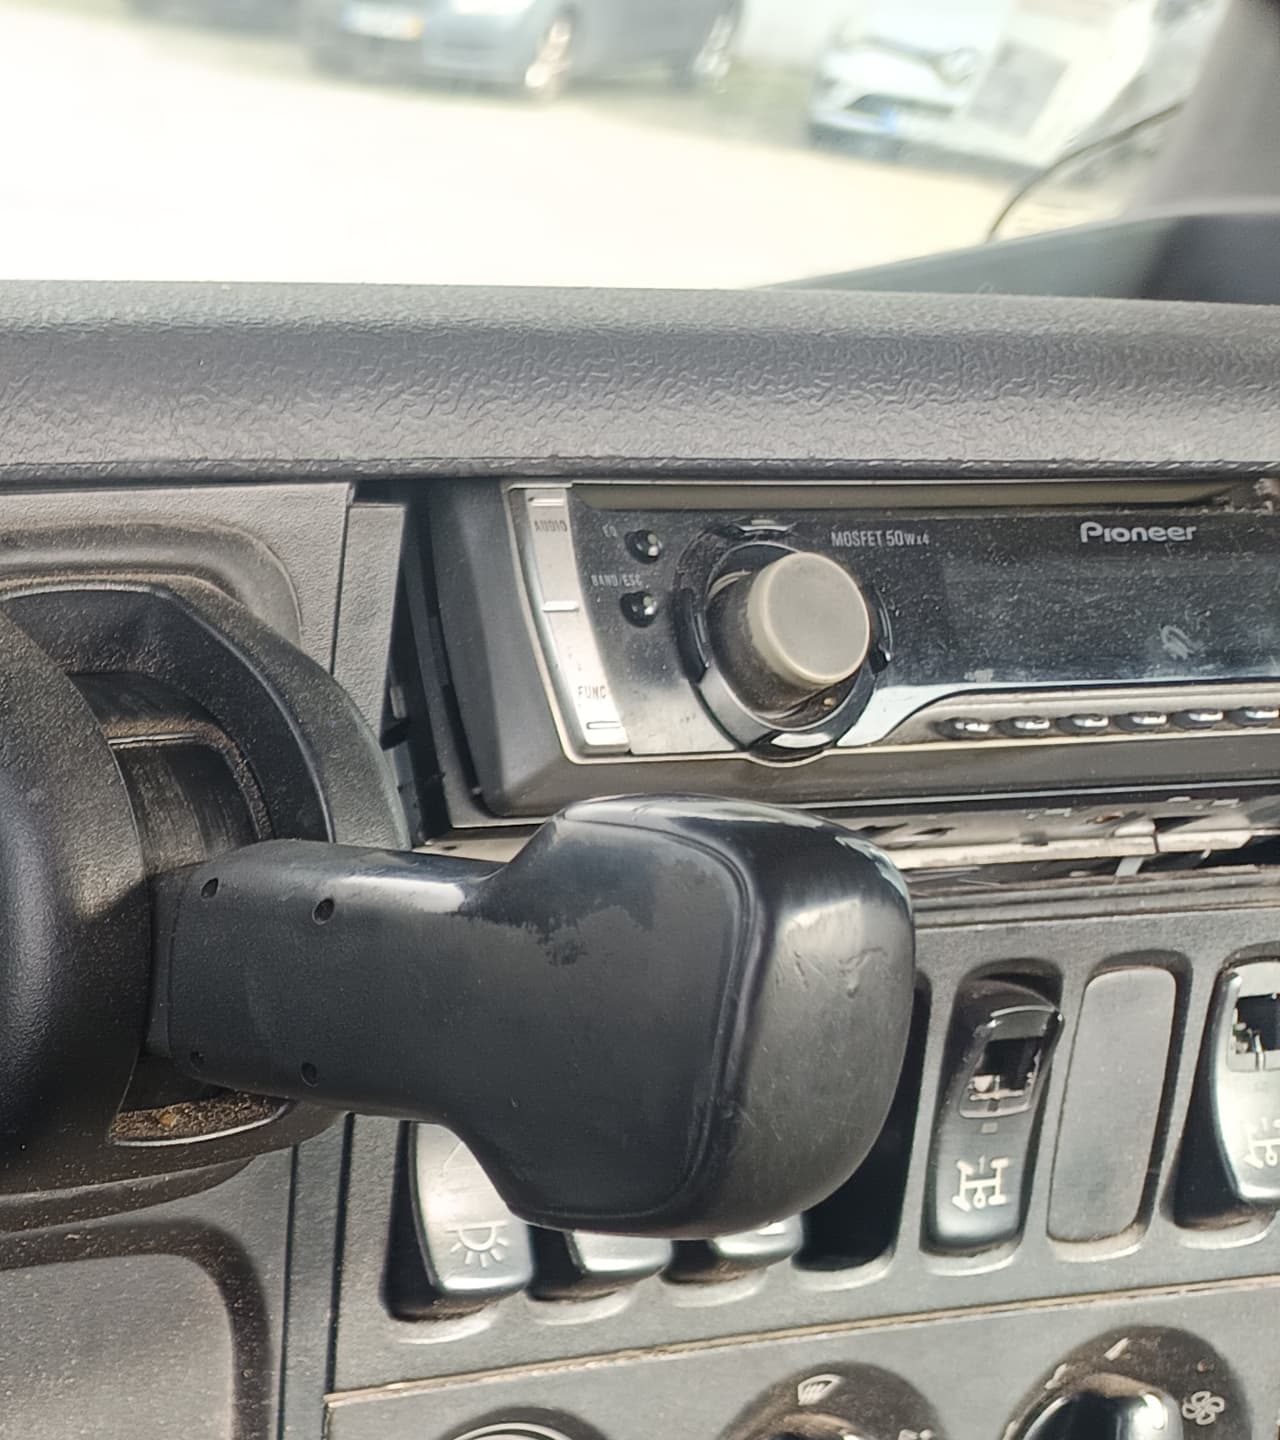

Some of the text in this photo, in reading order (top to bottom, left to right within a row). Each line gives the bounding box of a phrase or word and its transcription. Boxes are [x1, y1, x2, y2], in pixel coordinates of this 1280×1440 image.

[831, 529, 883, 547] MOSFET
[1080, 521, 1198, 543] Pioneer
[577, 685, 607, 699] FUNC
